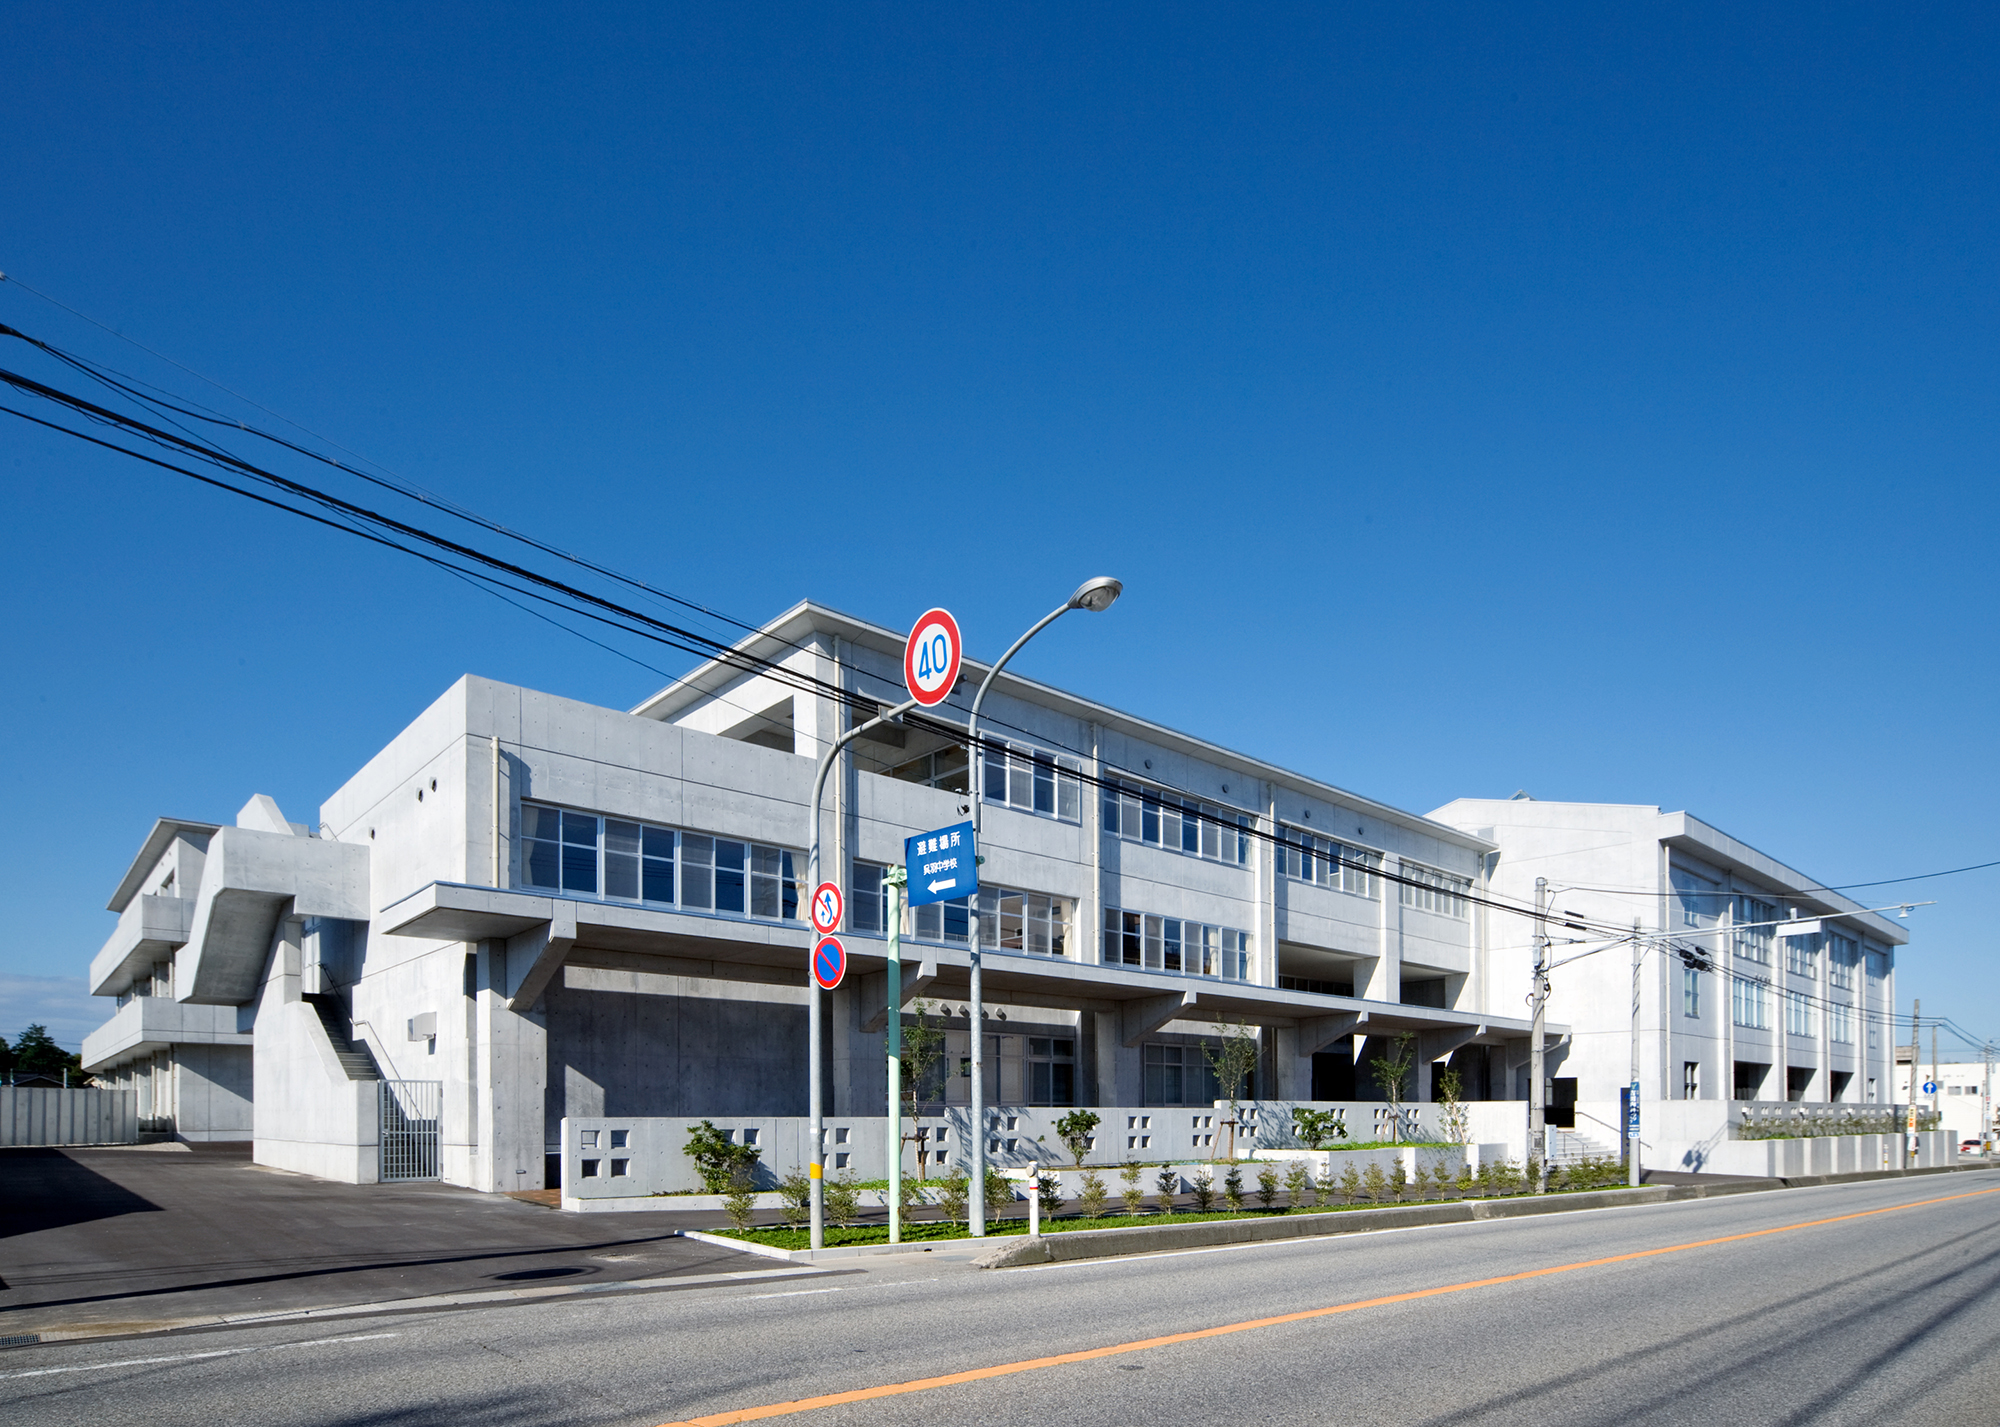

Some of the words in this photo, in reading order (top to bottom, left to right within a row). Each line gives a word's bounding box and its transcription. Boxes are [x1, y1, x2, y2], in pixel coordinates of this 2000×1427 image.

[918, 633, 947, 680] 40
[916, 831, 961, 856] 避難場所
[923, 857, 958, 876] 呉羽中学校
